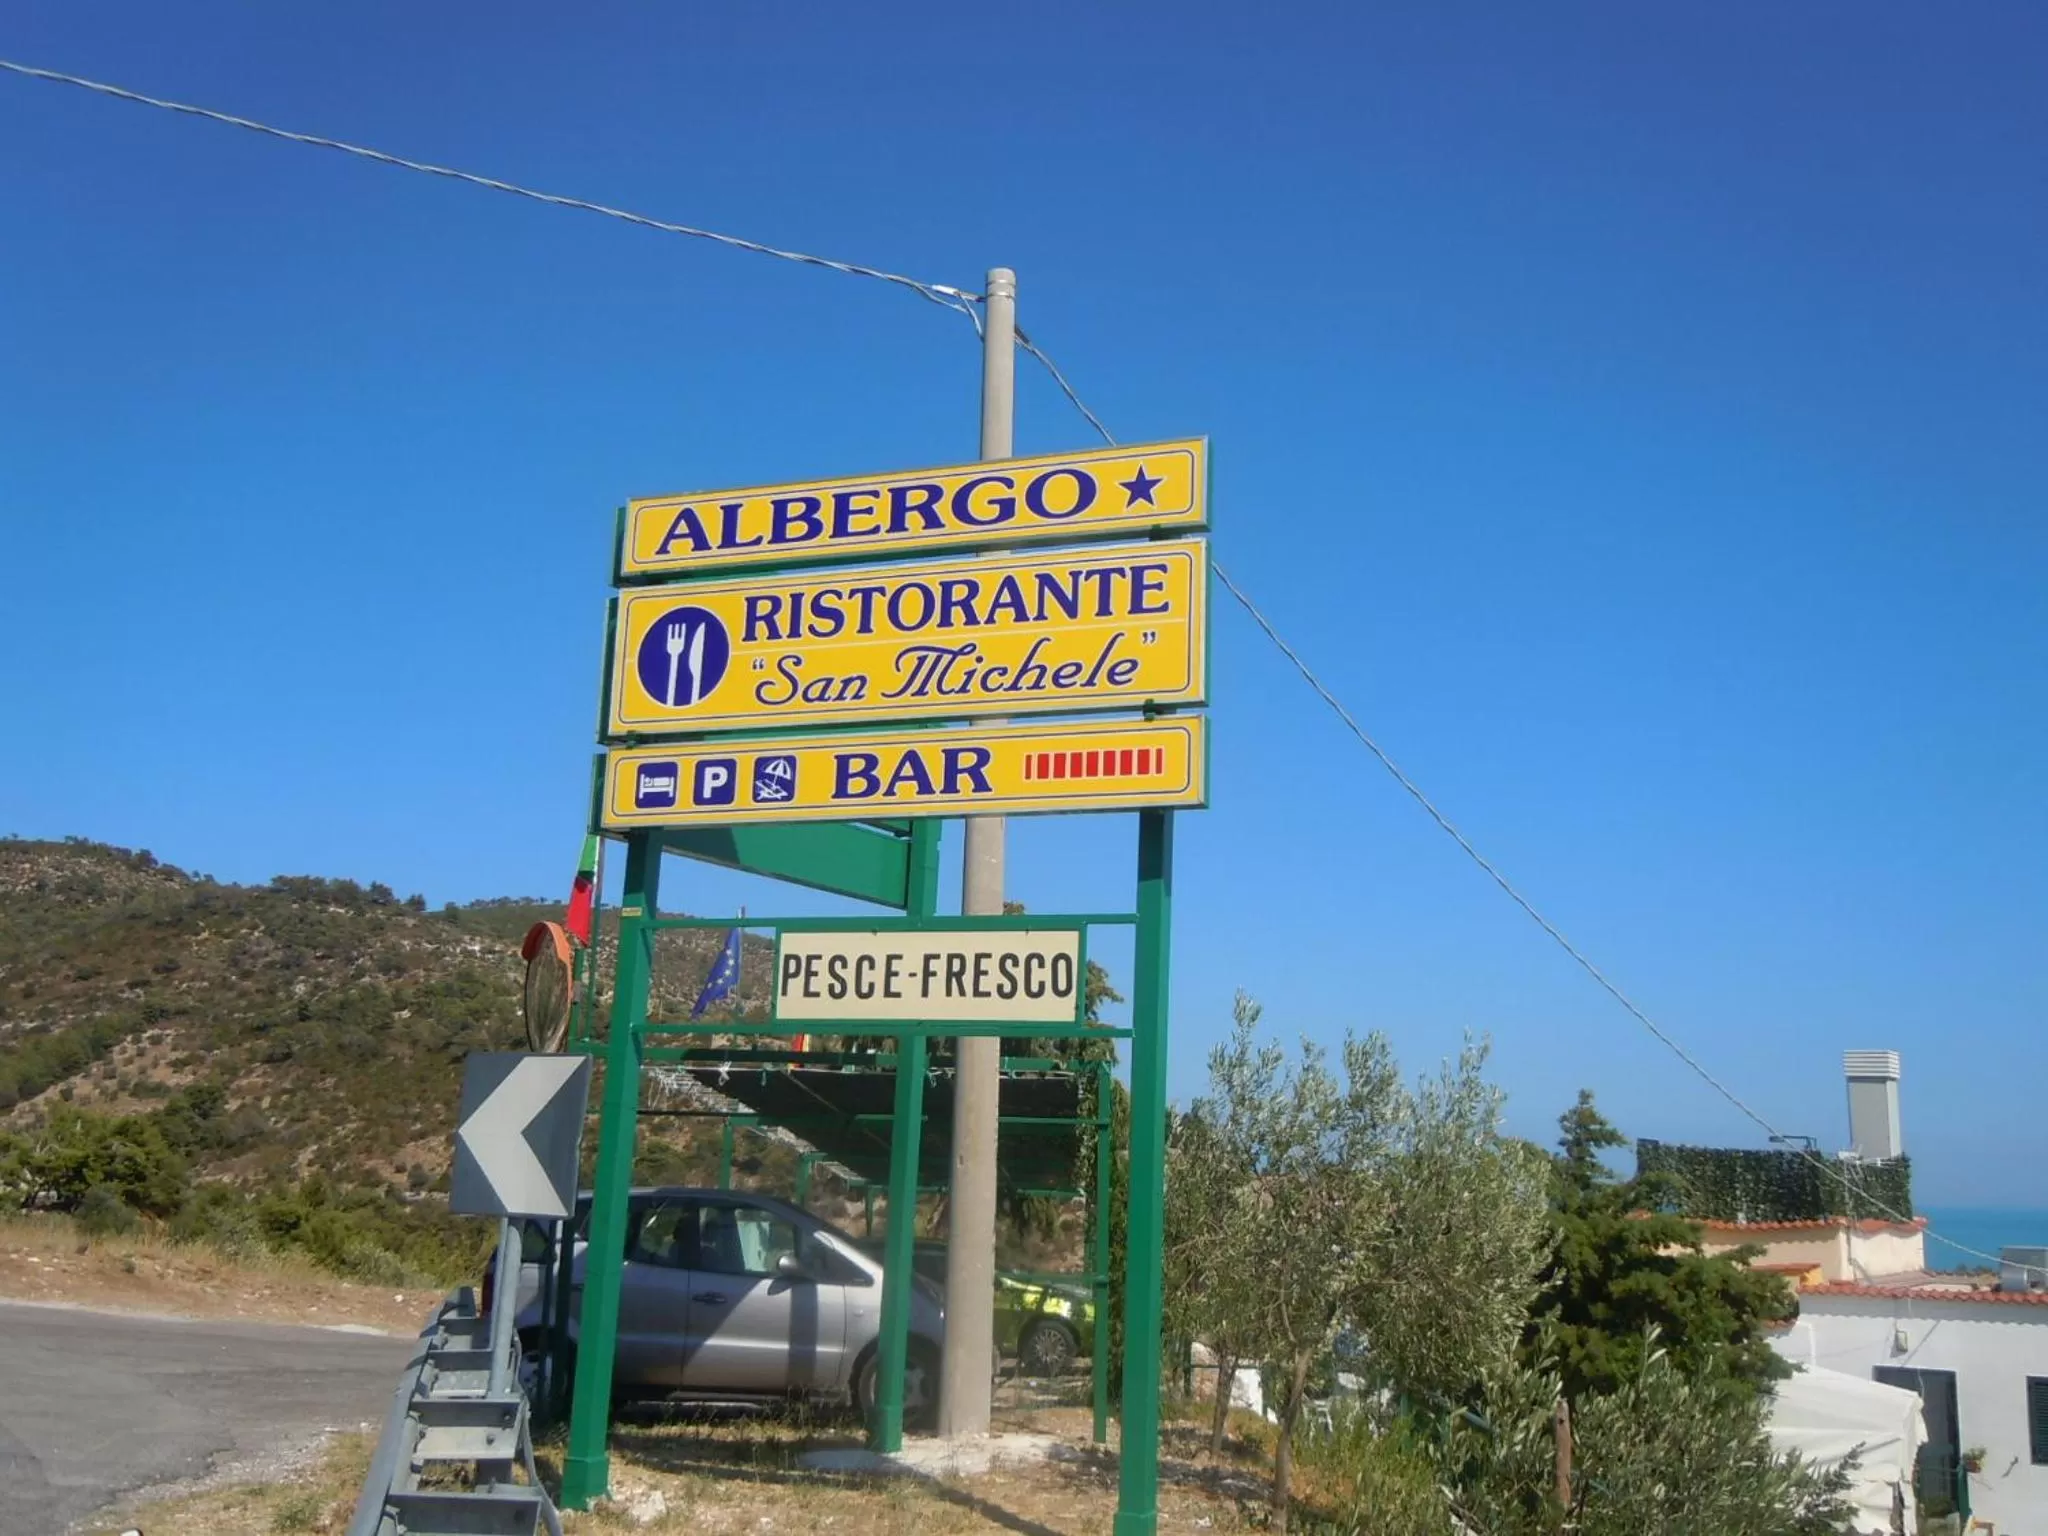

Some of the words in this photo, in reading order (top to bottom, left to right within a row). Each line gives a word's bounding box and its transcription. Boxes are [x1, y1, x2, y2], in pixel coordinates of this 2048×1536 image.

[655, 468, 1098, 556] ALBERGO
[741, 563, 1170, 643] RISTORANTE
[703, 766, 727, 796] P
[831, 746, 993, 799] BAR
[781, 952, 1075, 999] PESCE-FRESCO
